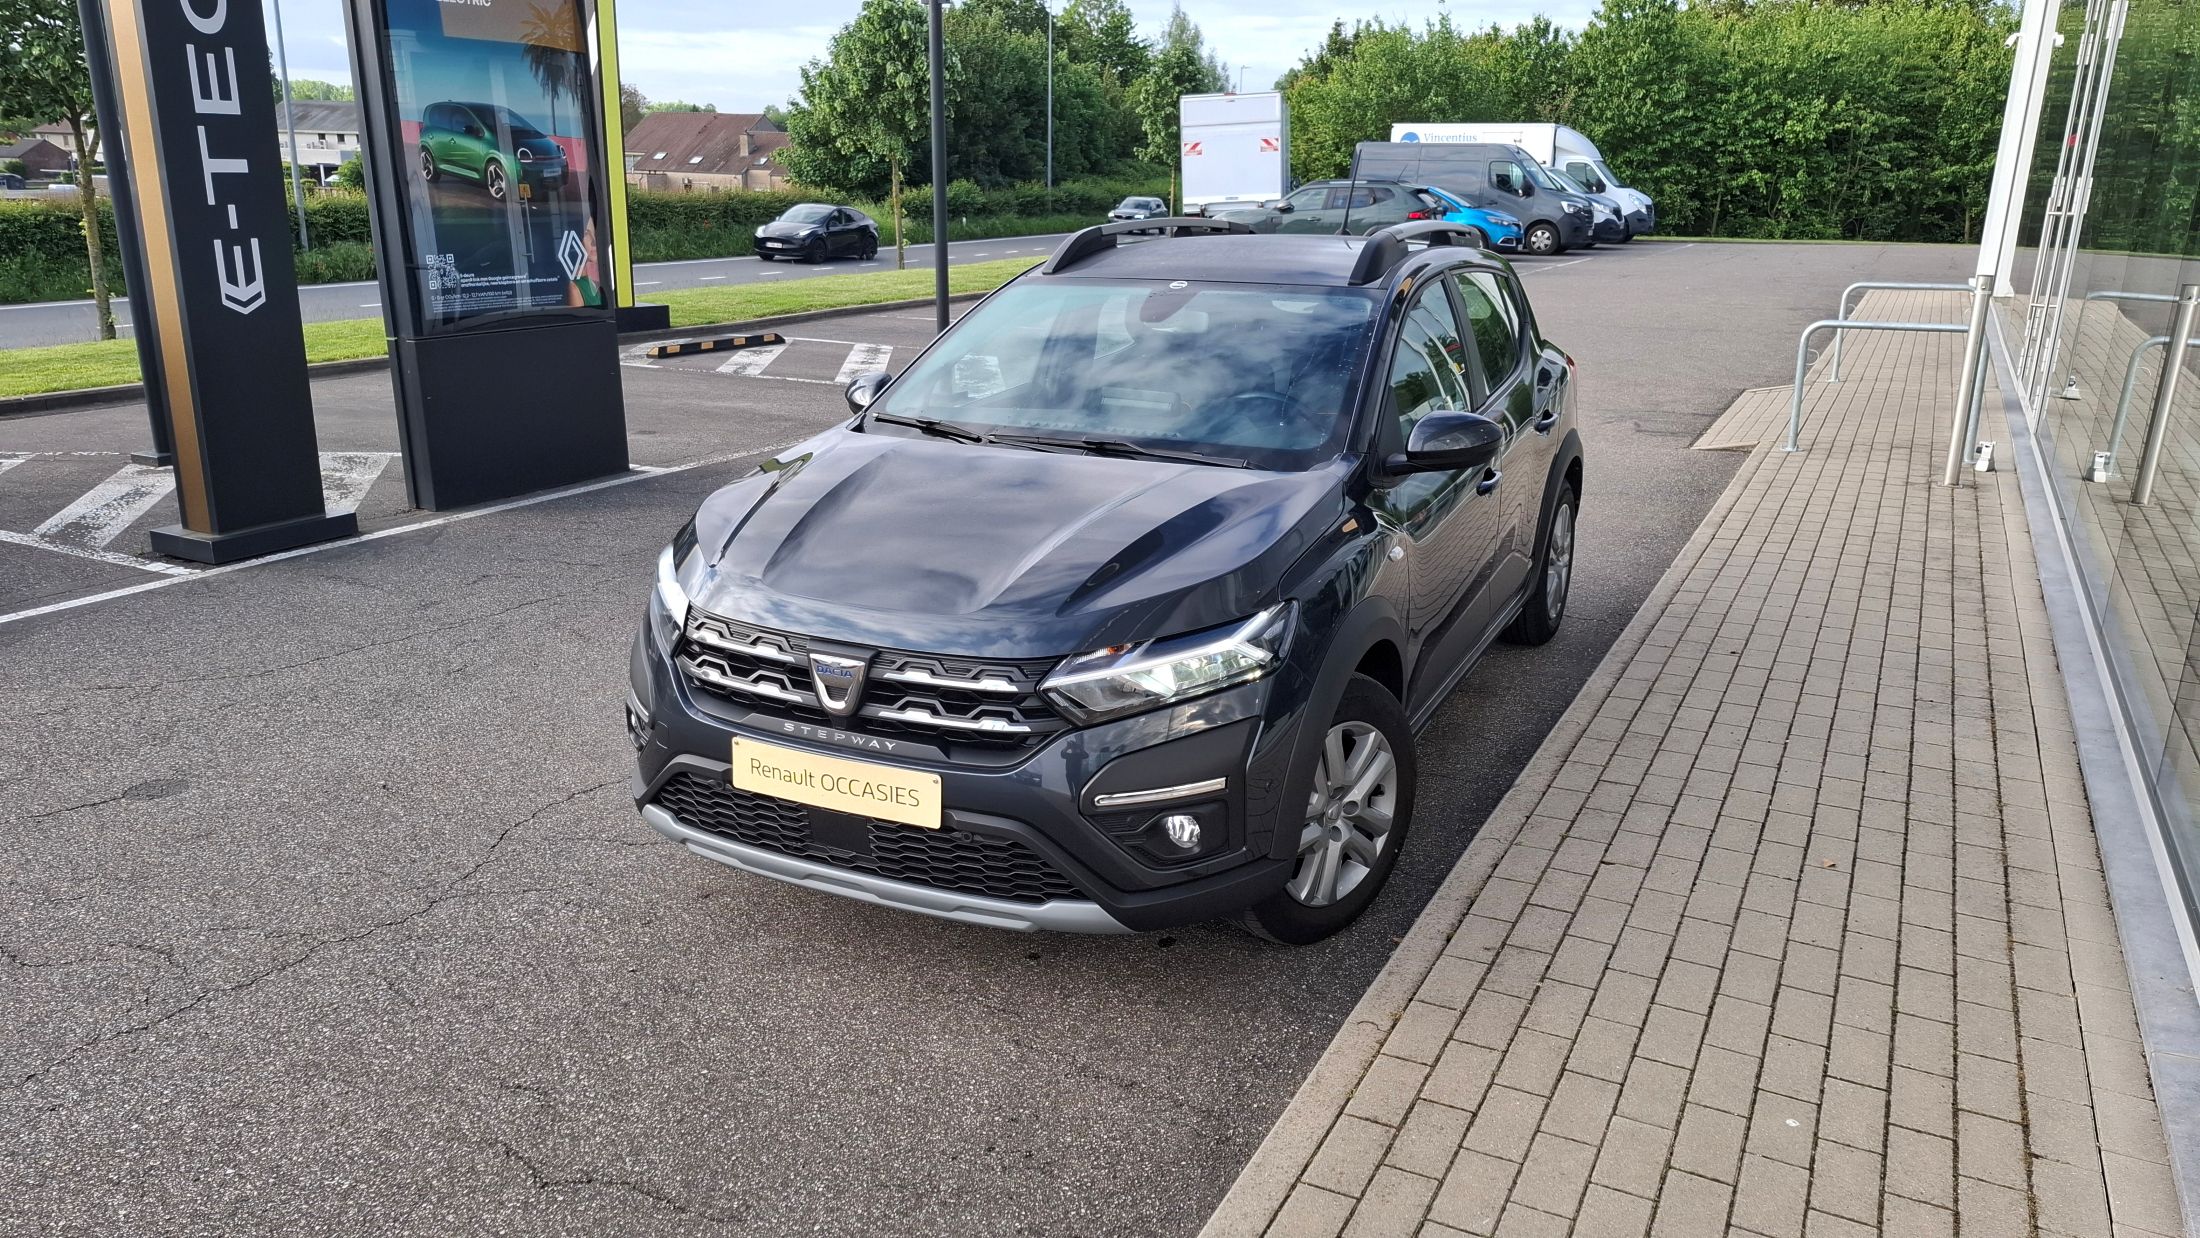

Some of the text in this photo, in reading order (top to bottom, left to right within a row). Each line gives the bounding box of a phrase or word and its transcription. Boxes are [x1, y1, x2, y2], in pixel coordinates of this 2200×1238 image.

[1424, 133, 1478, 142] Vincentius
[816, 664, 853, 678] DACIA
[783, 723, 896, 751] STEPWAY
[750, 757, 920, 807] Renault OCCASIES
